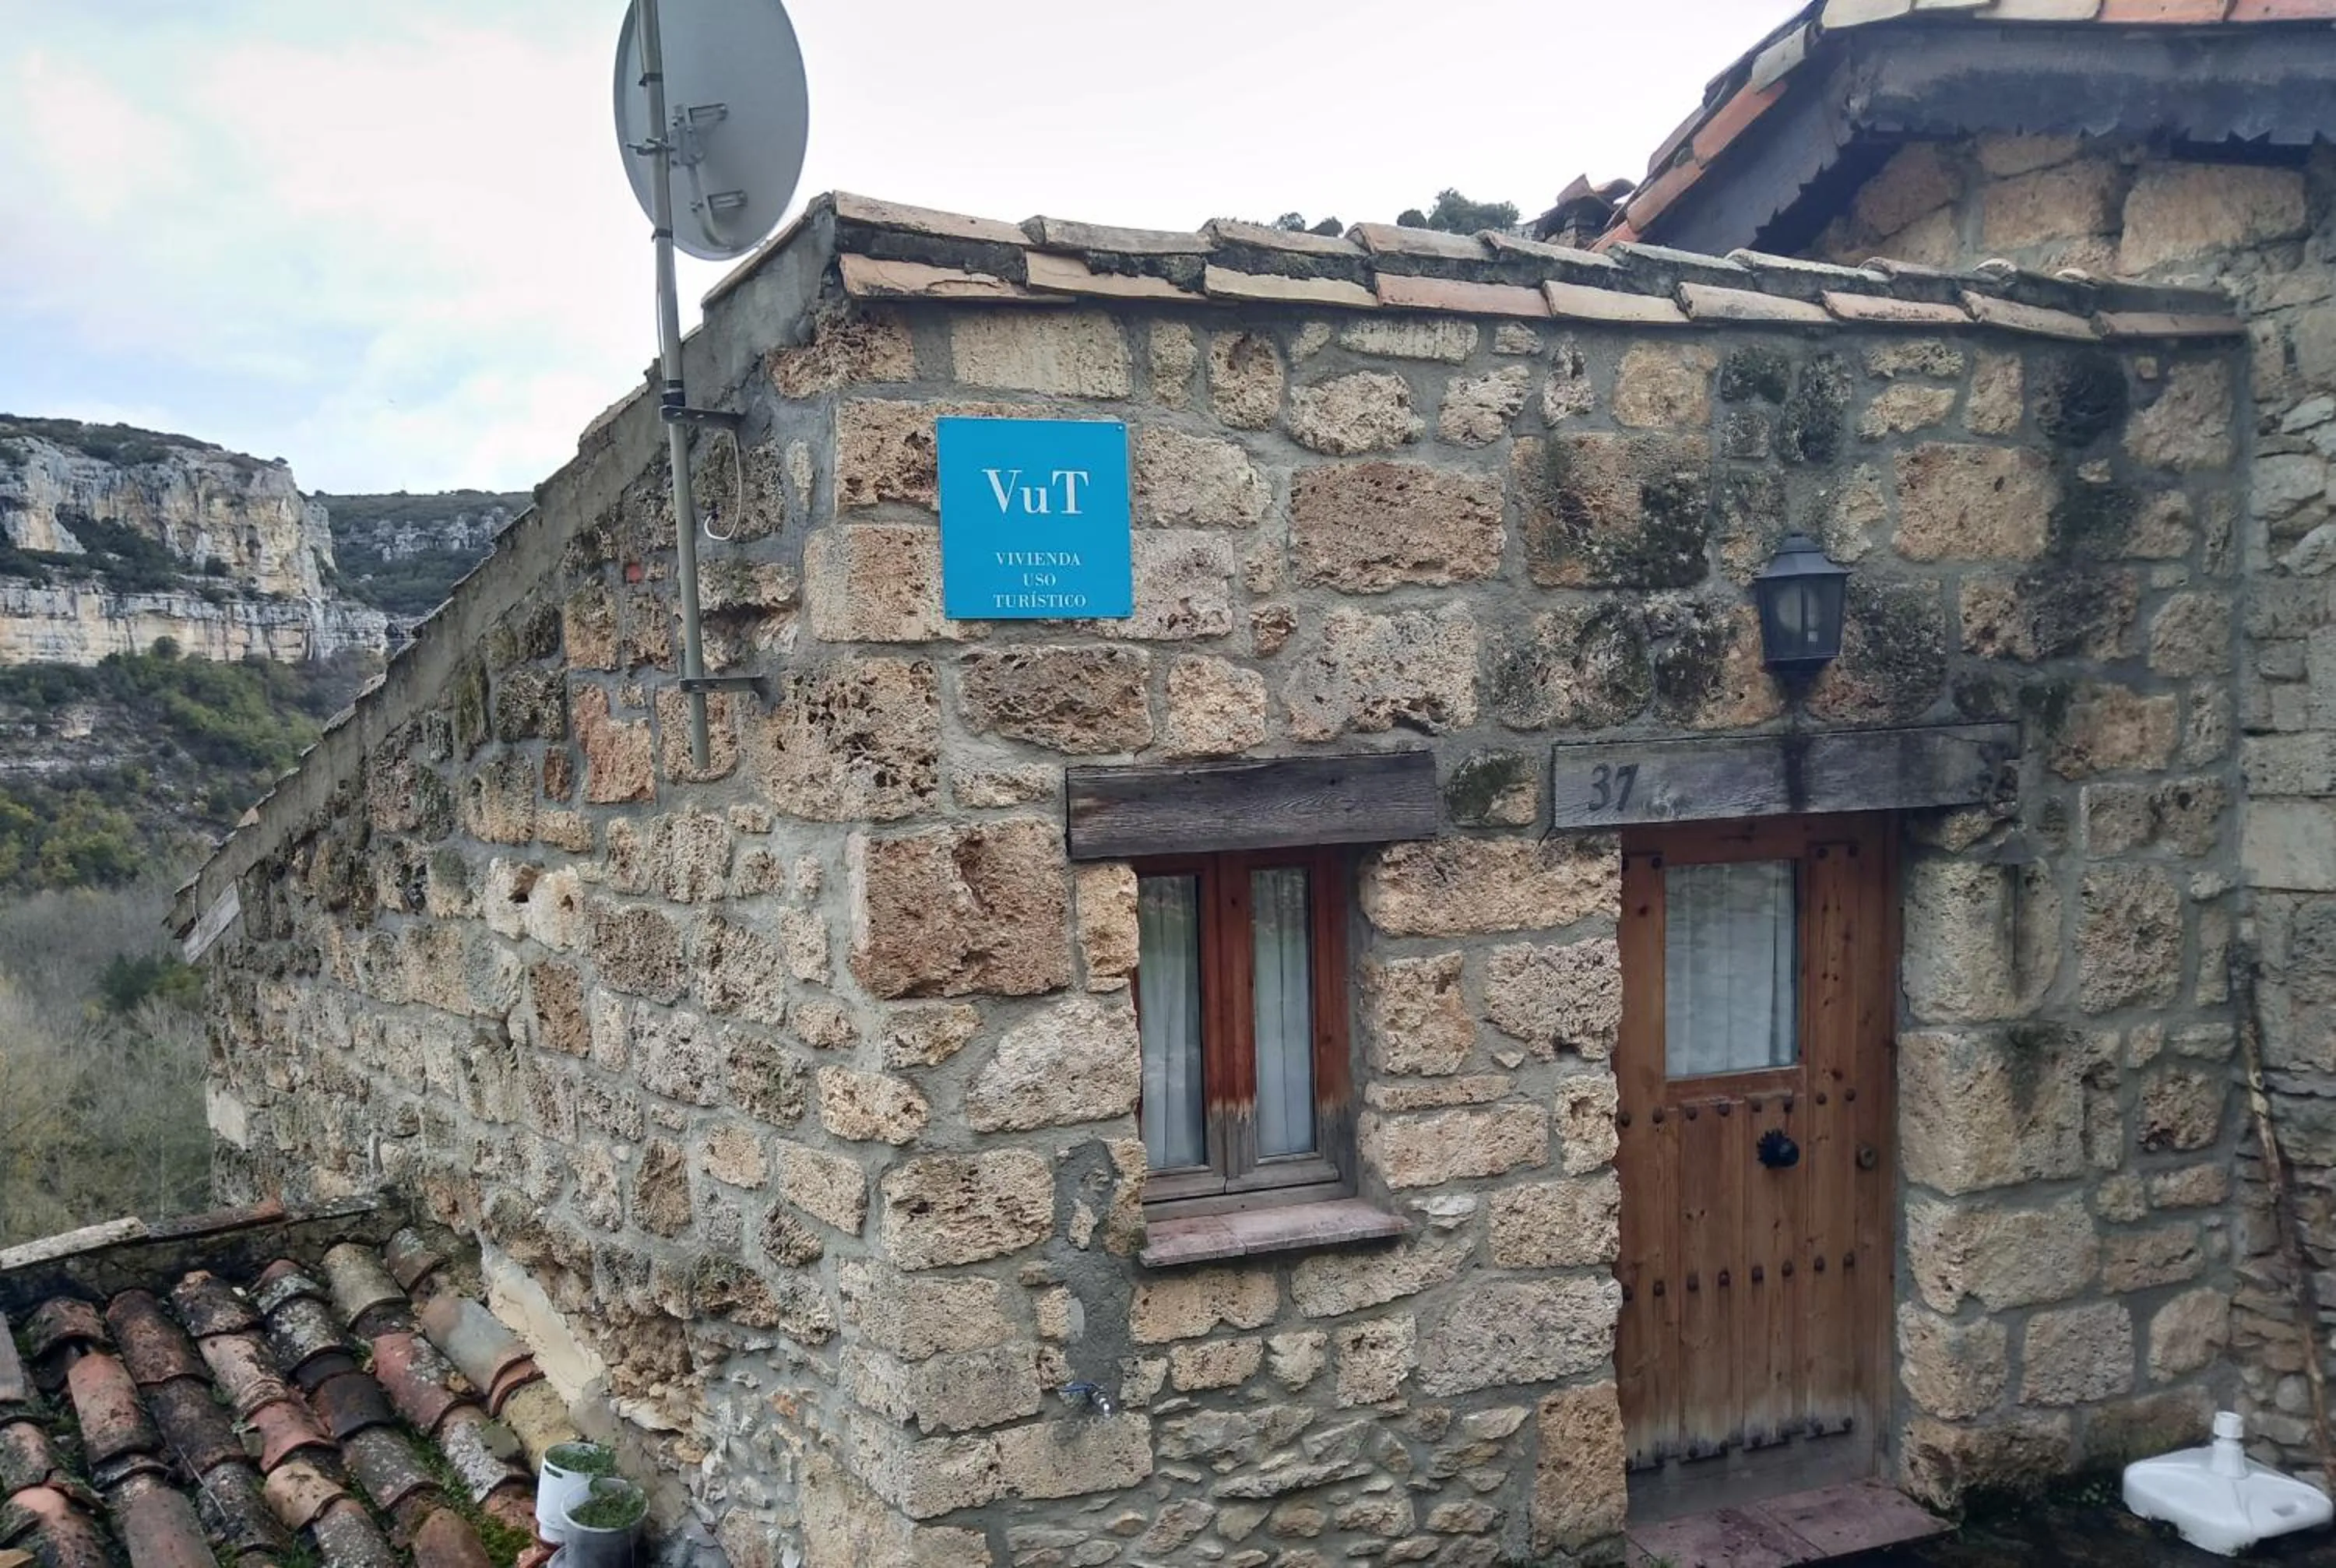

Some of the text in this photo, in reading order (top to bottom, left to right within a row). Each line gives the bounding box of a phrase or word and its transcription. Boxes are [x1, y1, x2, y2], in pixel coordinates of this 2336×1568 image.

[982, 469, 1089, 514] VuT
[996, 552, 1081, 566] VIVIENDA
[1023, 573, 1056, 587] USO
[994, 591, 1086, 608] TURÍSTICO
[1587, 762, 1640, 811] 37
